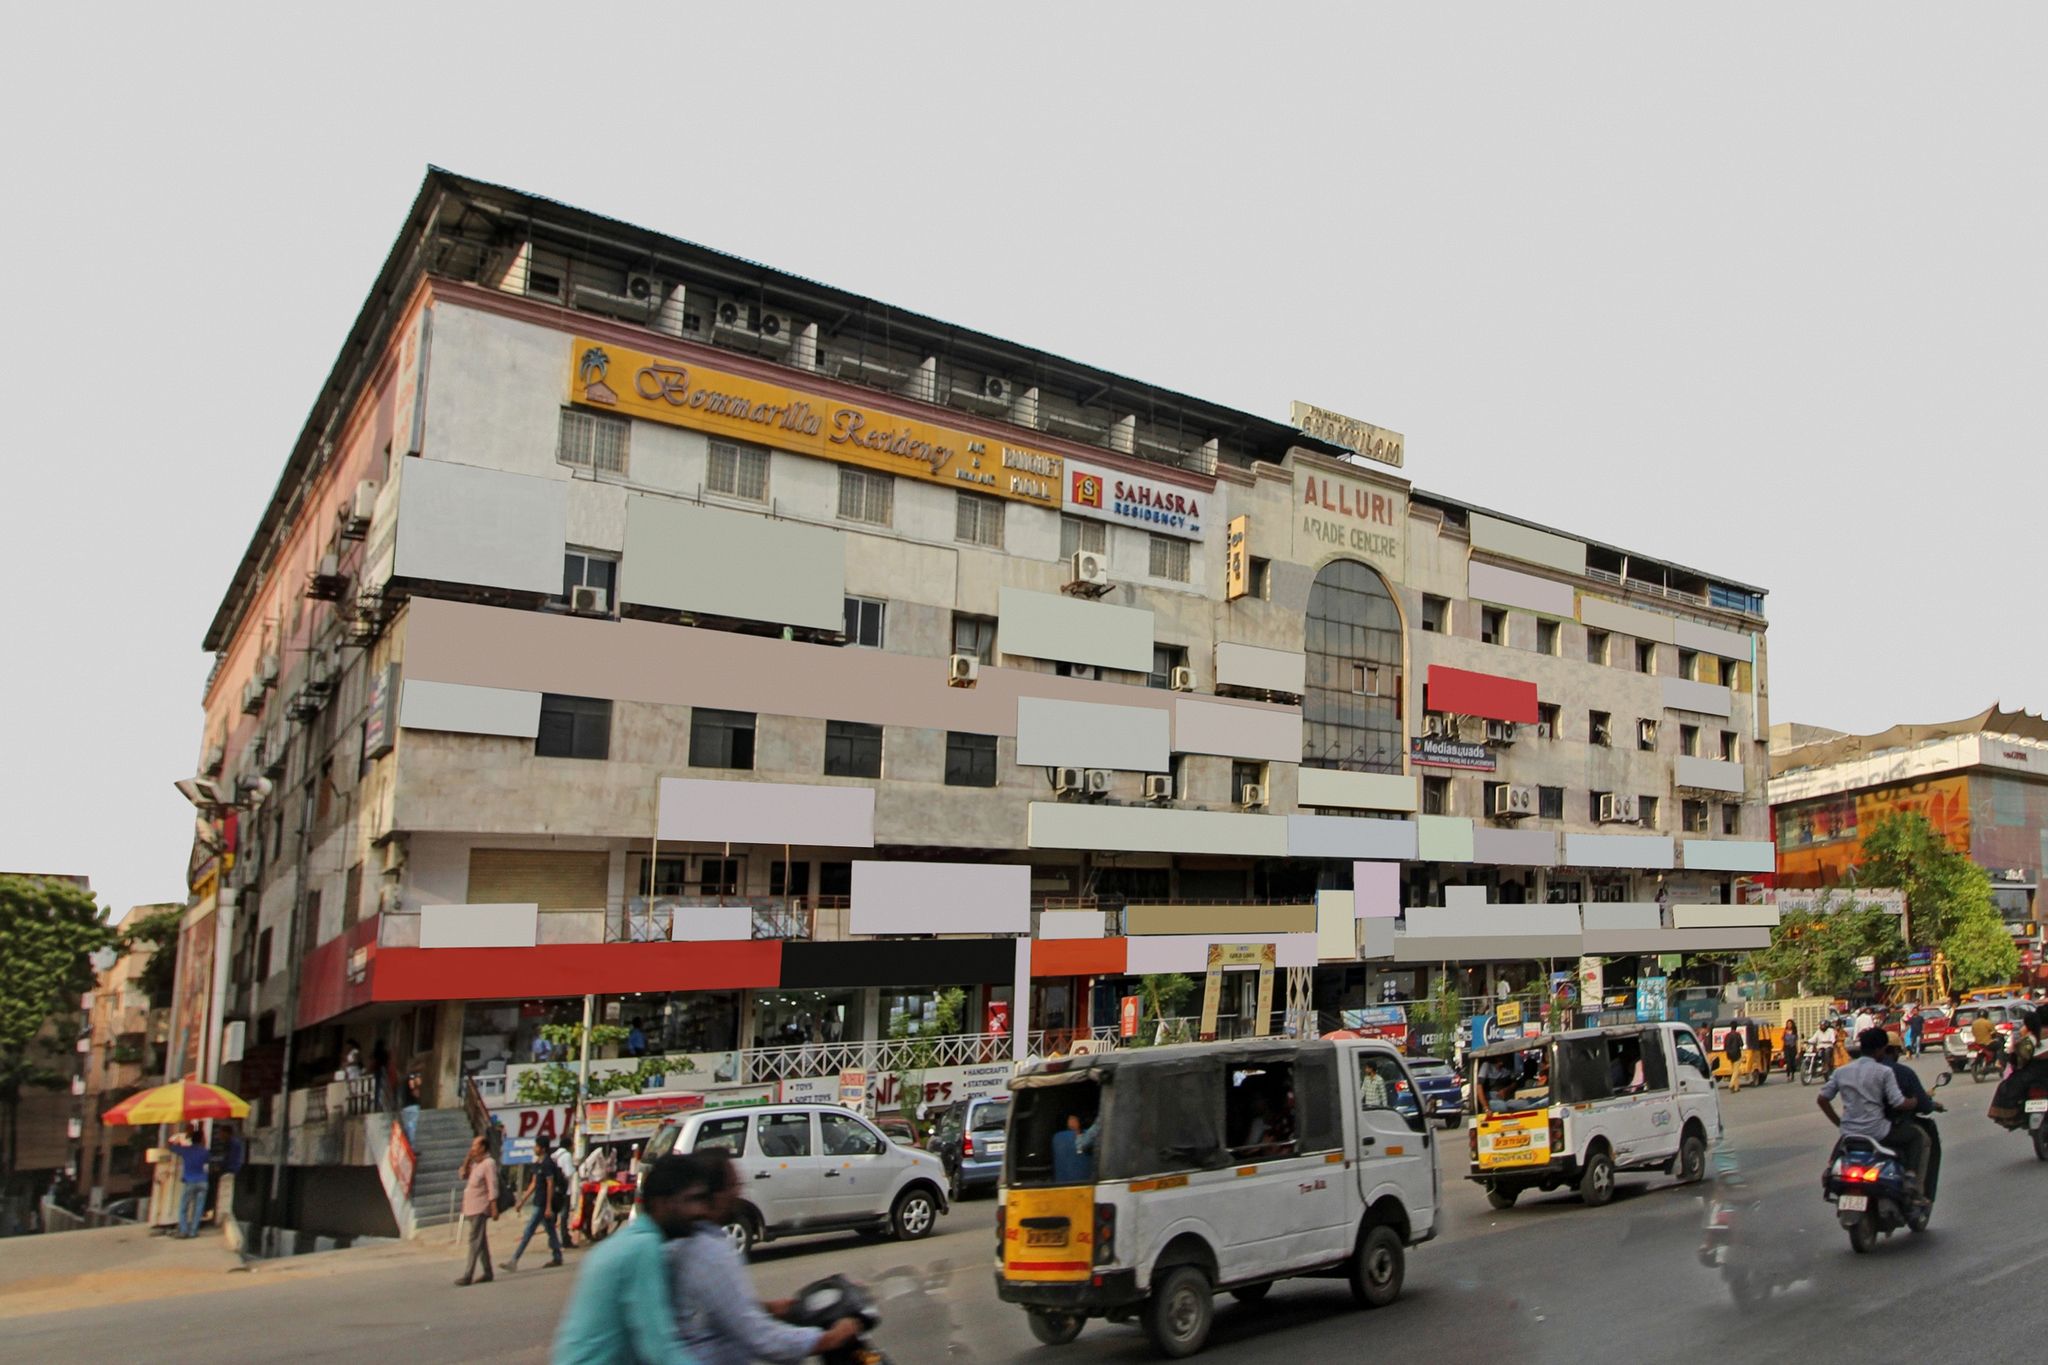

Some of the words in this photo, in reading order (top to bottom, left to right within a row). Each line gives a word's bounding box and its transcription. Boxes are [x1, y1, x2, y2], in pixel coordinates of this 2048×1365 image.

[1114, 480, 1200, 518] SAHASRA
[1114, 502, 1185, 528] RESIDENCY
[1304, 475, 1393, 526] ALLURI
[795, 1082, 813, 1091] TOYS
